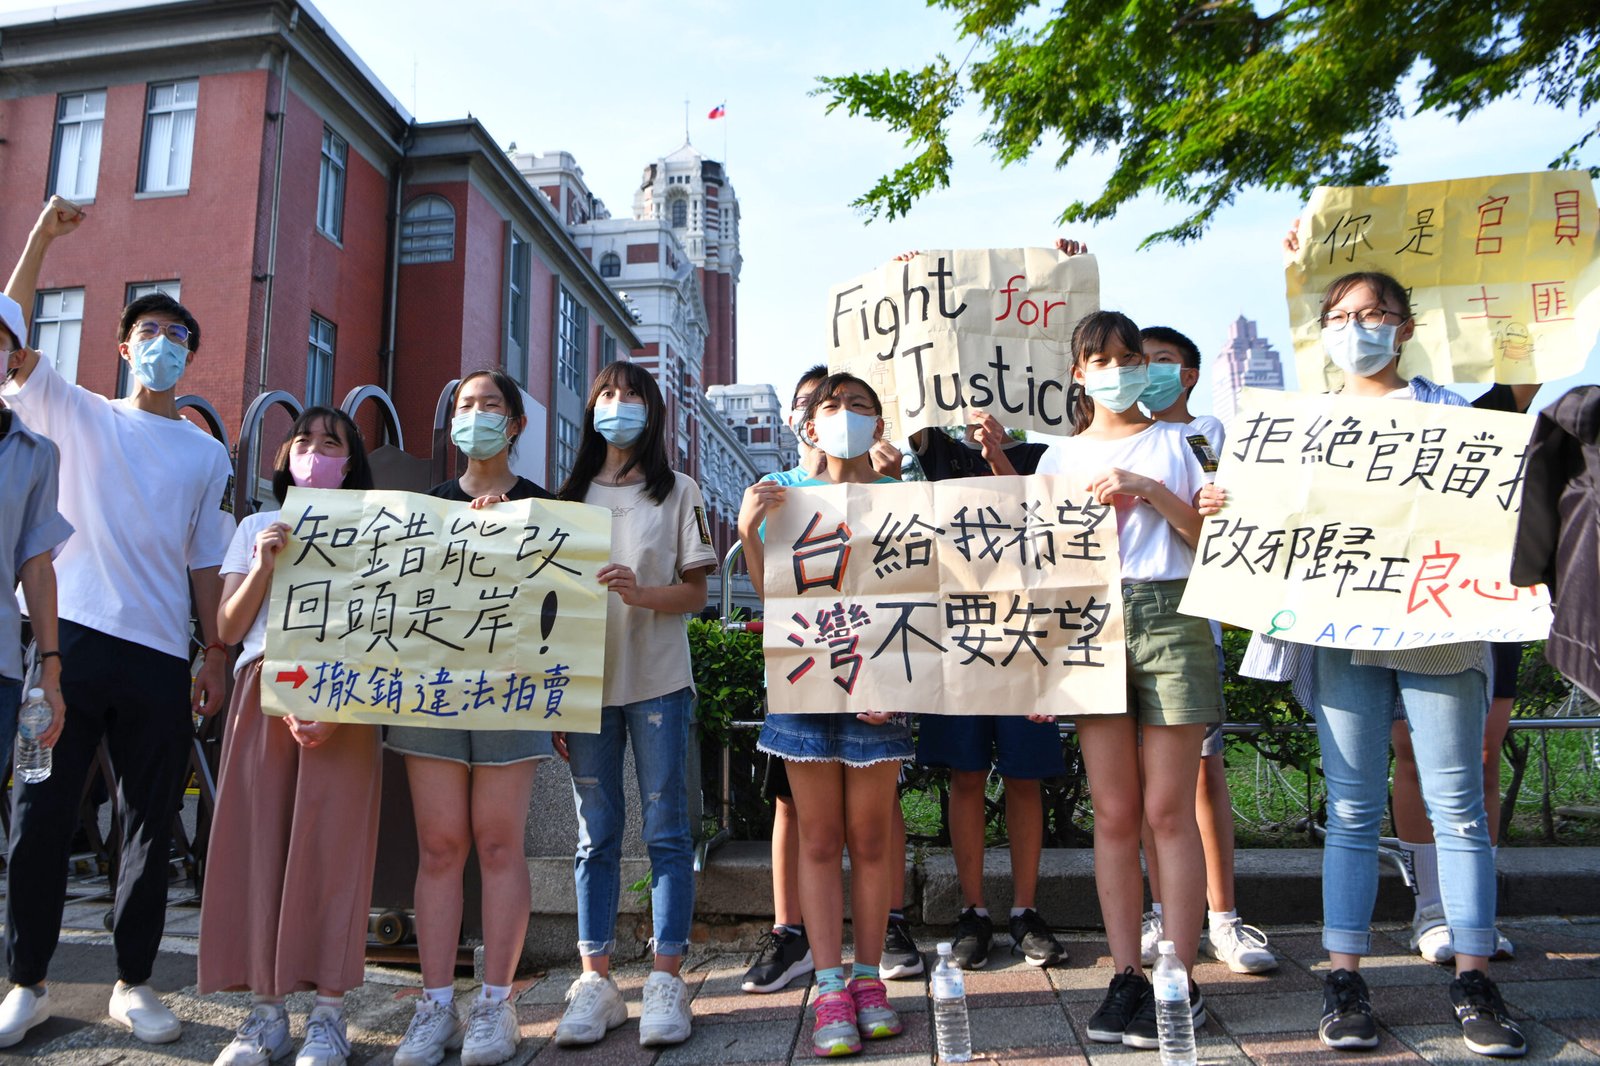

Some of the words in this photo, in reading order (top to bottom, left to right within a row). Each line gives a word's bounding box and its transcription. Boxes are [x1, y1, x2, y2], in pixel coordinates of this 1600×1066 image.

[832, 257, 968, 361] Fight
[995, 275, 1067, 328] for
[292, 505, 583, 587] 知錯能改
[308, 661, 571, 719] 撤銷違法拍賣
